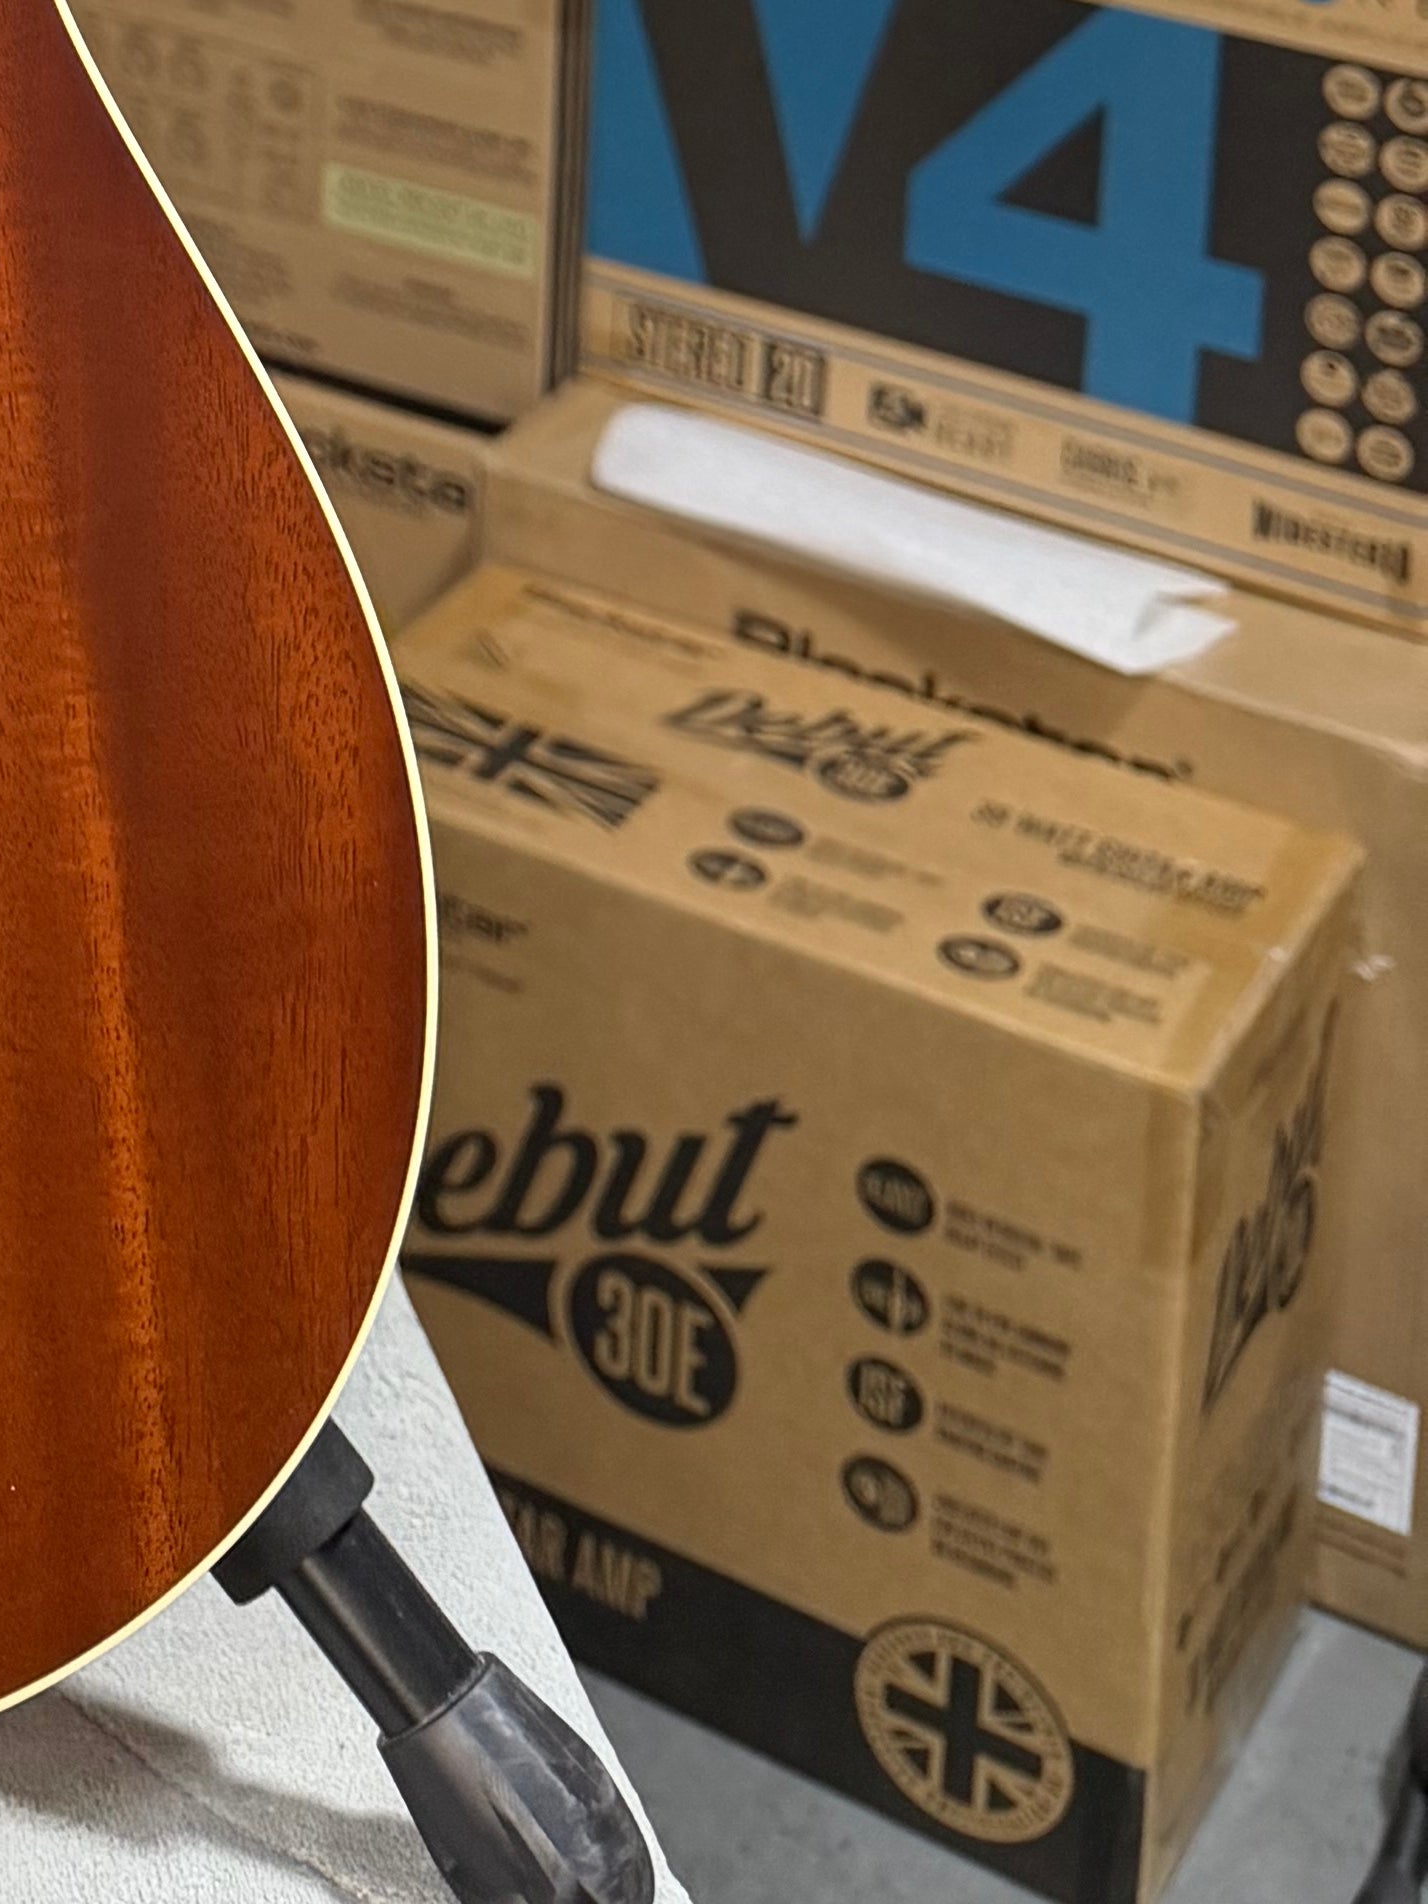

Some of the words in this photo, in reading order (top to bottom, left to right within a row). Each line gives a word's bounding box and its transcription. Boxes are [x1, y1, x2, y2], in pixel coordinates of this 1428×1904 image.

[628, 302, 747, 394] STEREO
[416, 1077, 800, 1249] ebut
[593, 1266, 715, 1420] 30E
[571, 1529, 664, 1625] AMP
